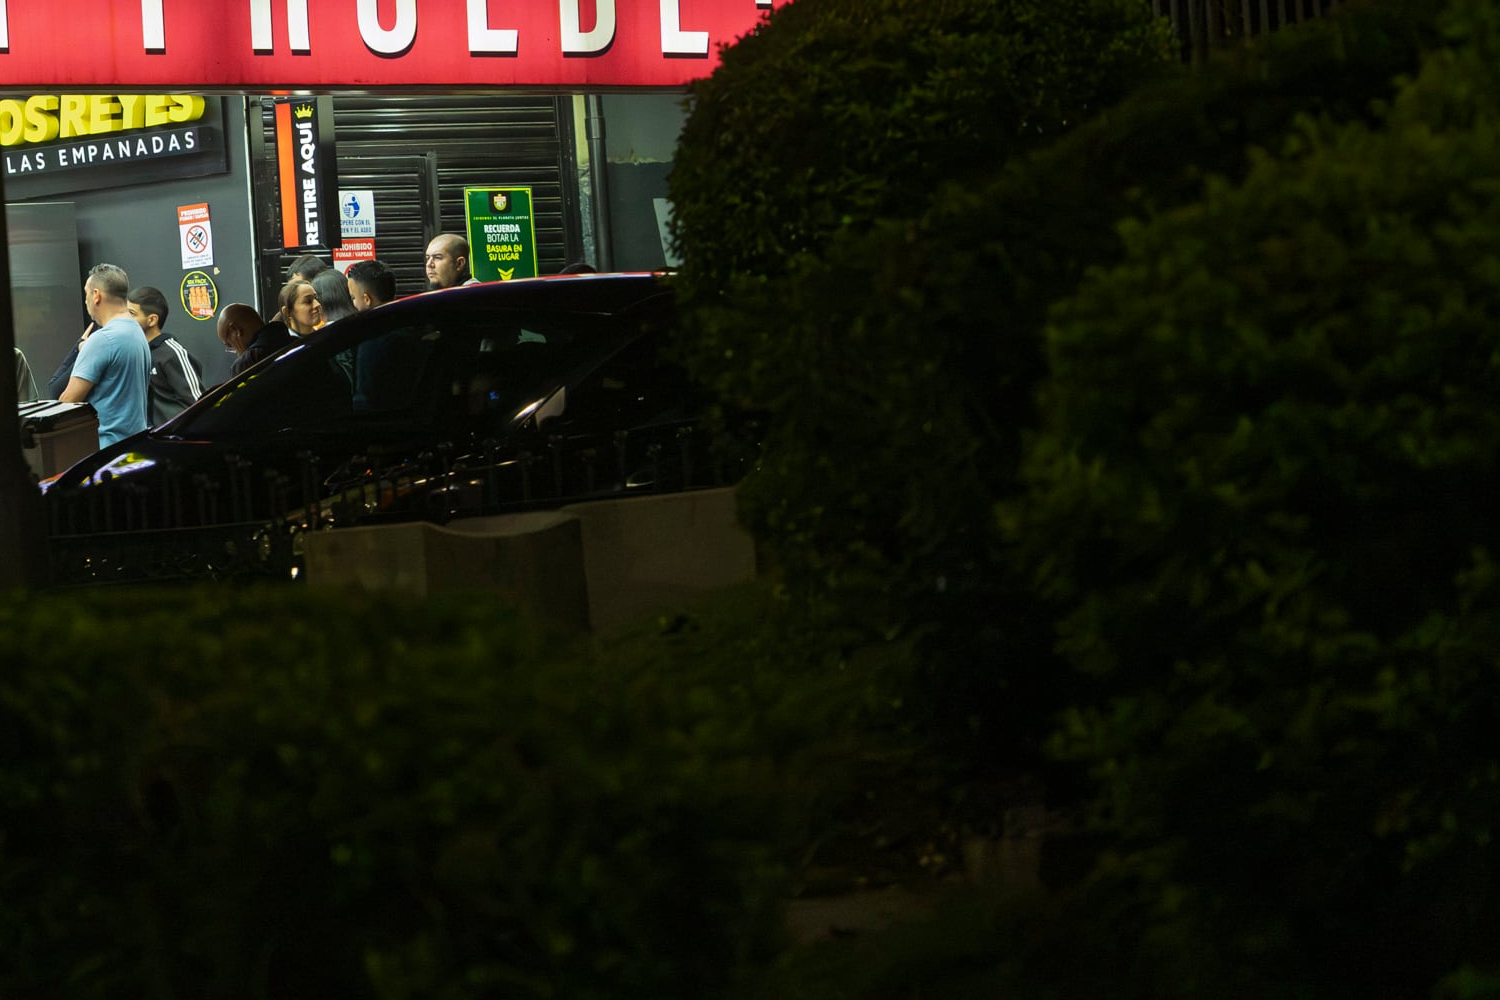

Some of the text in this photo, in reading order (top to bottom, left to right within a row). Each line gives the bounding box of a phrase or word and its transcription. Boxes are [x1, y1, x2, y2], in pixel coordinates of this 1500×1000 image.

[295, 122, 316, 174] AQUÍ
[6, 152, 46, 175] LAS
[58, 131, 196, 167] EMPANADAS
[303, 178, 319, 246] RETIRE
[484, 224, 520, 233] RECUERDA
[487, 233, 519, 243] BOTAR LA
[336, 243, 372, 251] OHIBIDO
[486, 244, 523, 253] BASURA EN
[489, 252, 520, 261] SU LUGAR
